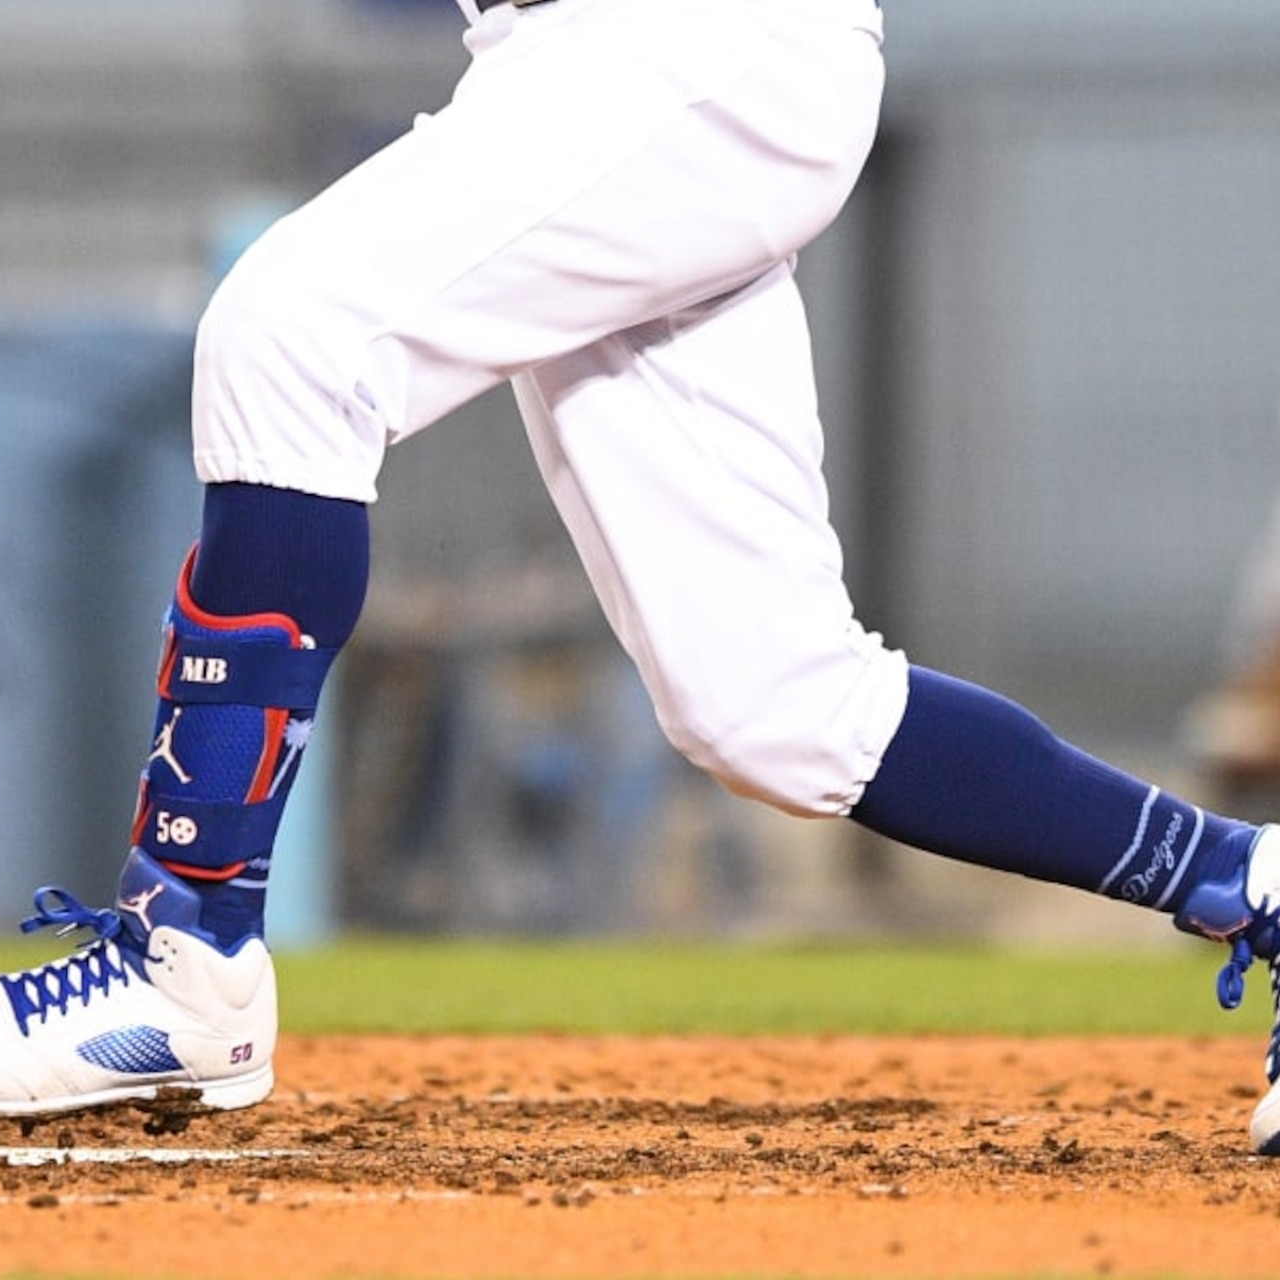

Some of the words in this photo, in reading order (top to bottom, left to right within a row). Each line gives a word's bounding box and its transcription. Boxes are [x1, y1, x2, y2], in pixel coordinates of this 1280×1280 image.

[180, 655, 228, 684] MB
[1121, 811, 1183, 899] Dodgers
[229, 1041, 253, 1065] 50
